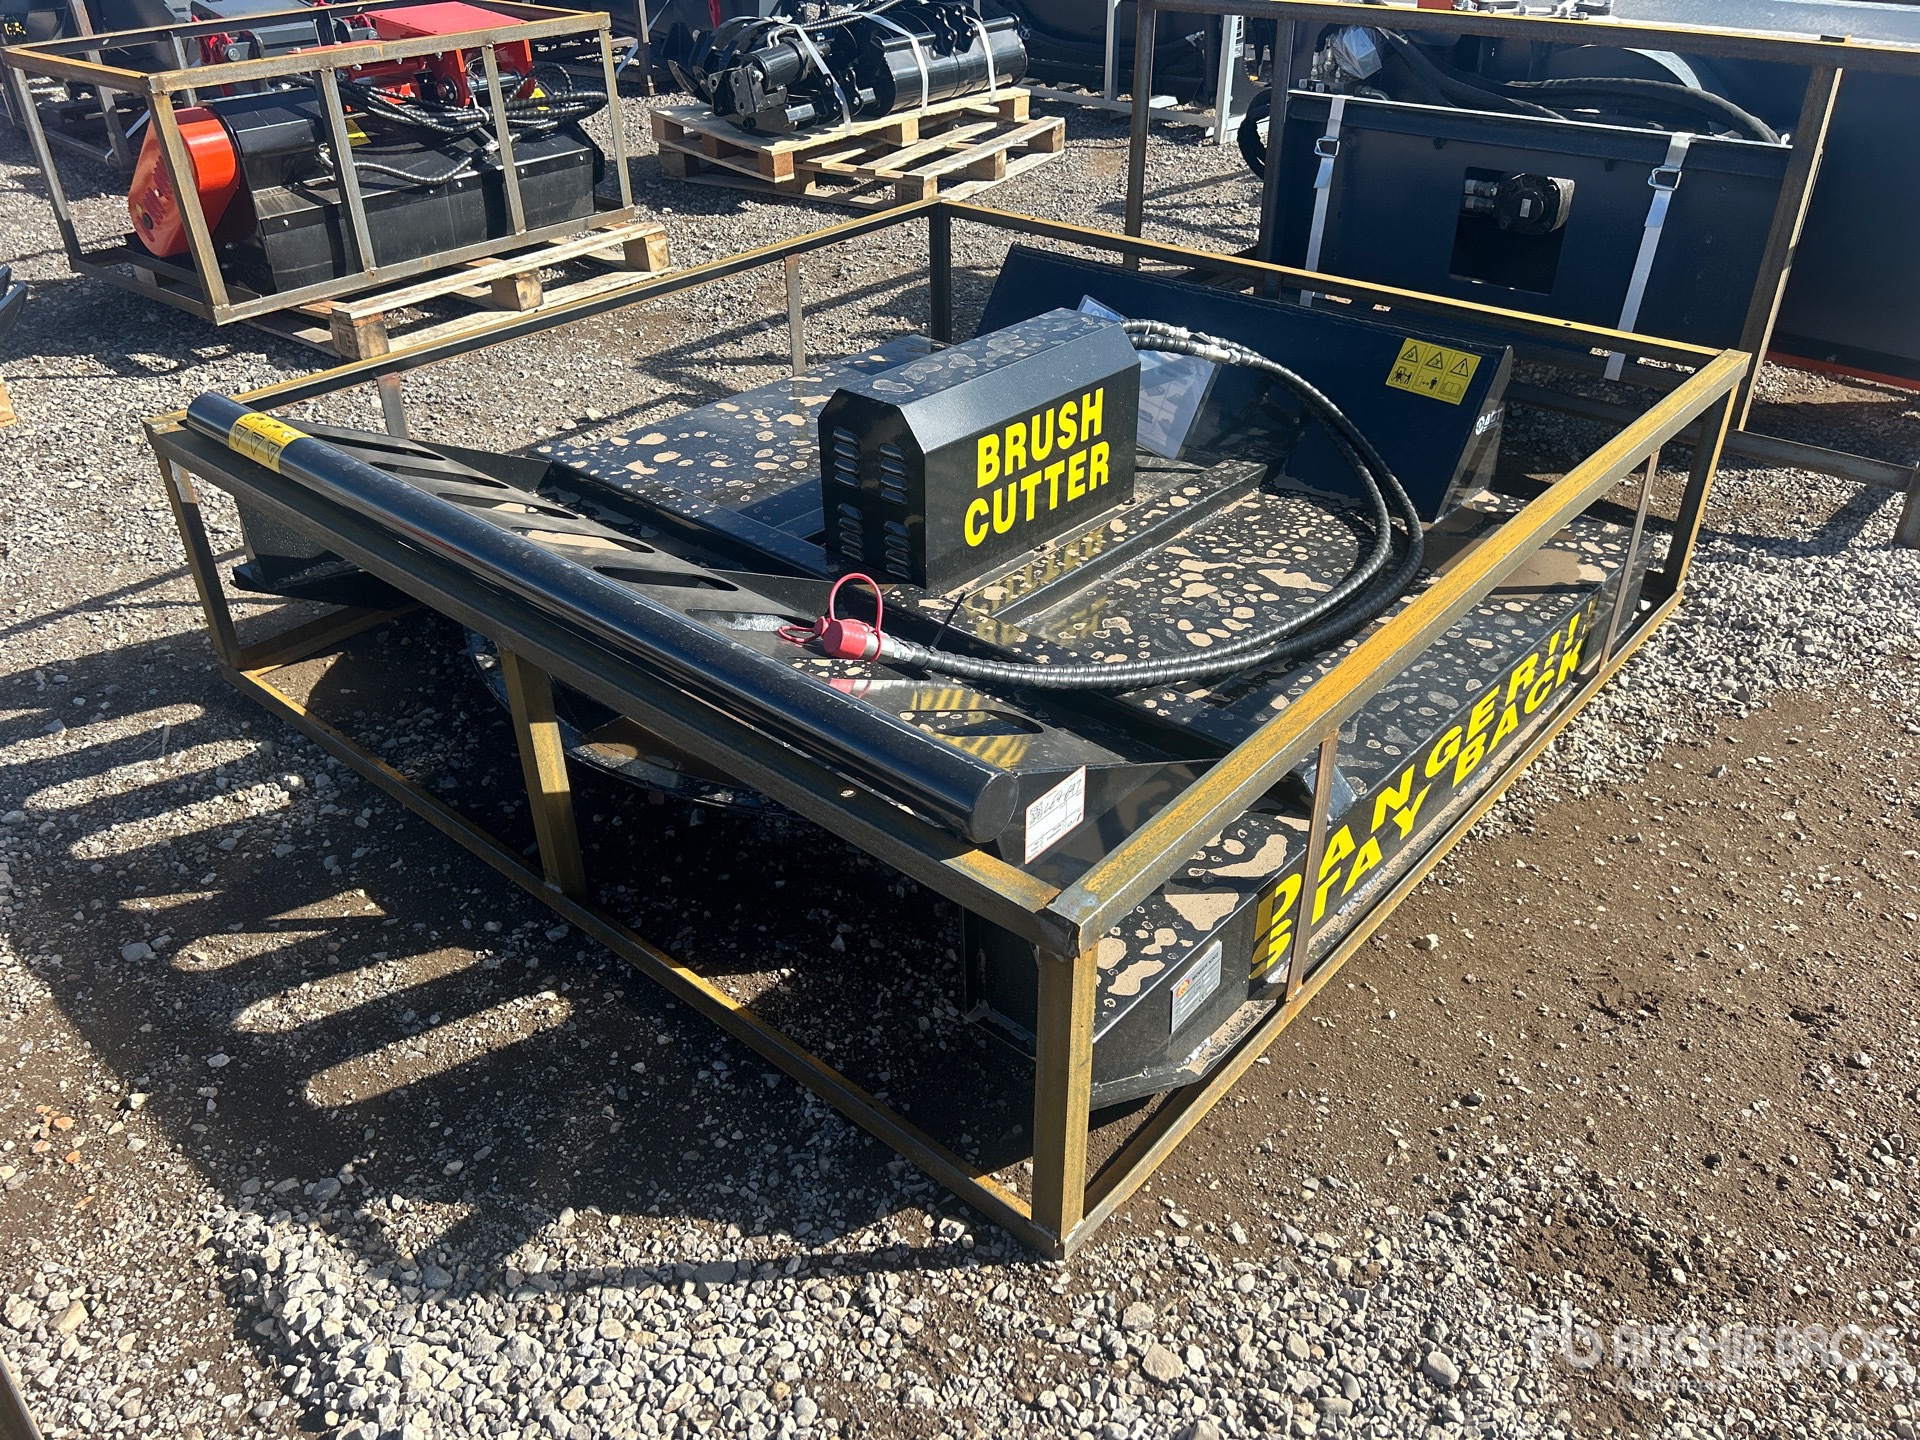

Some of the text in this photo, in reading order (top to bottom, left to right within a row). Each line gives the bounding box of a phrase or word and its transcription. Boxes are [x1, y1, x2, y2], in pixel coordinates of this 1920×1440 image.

[977, 387, 1104, 489] BRUSH
[964, 440, 1110, 547] CUTTER
[1248, 638, 1583, 980] STAY BACK
